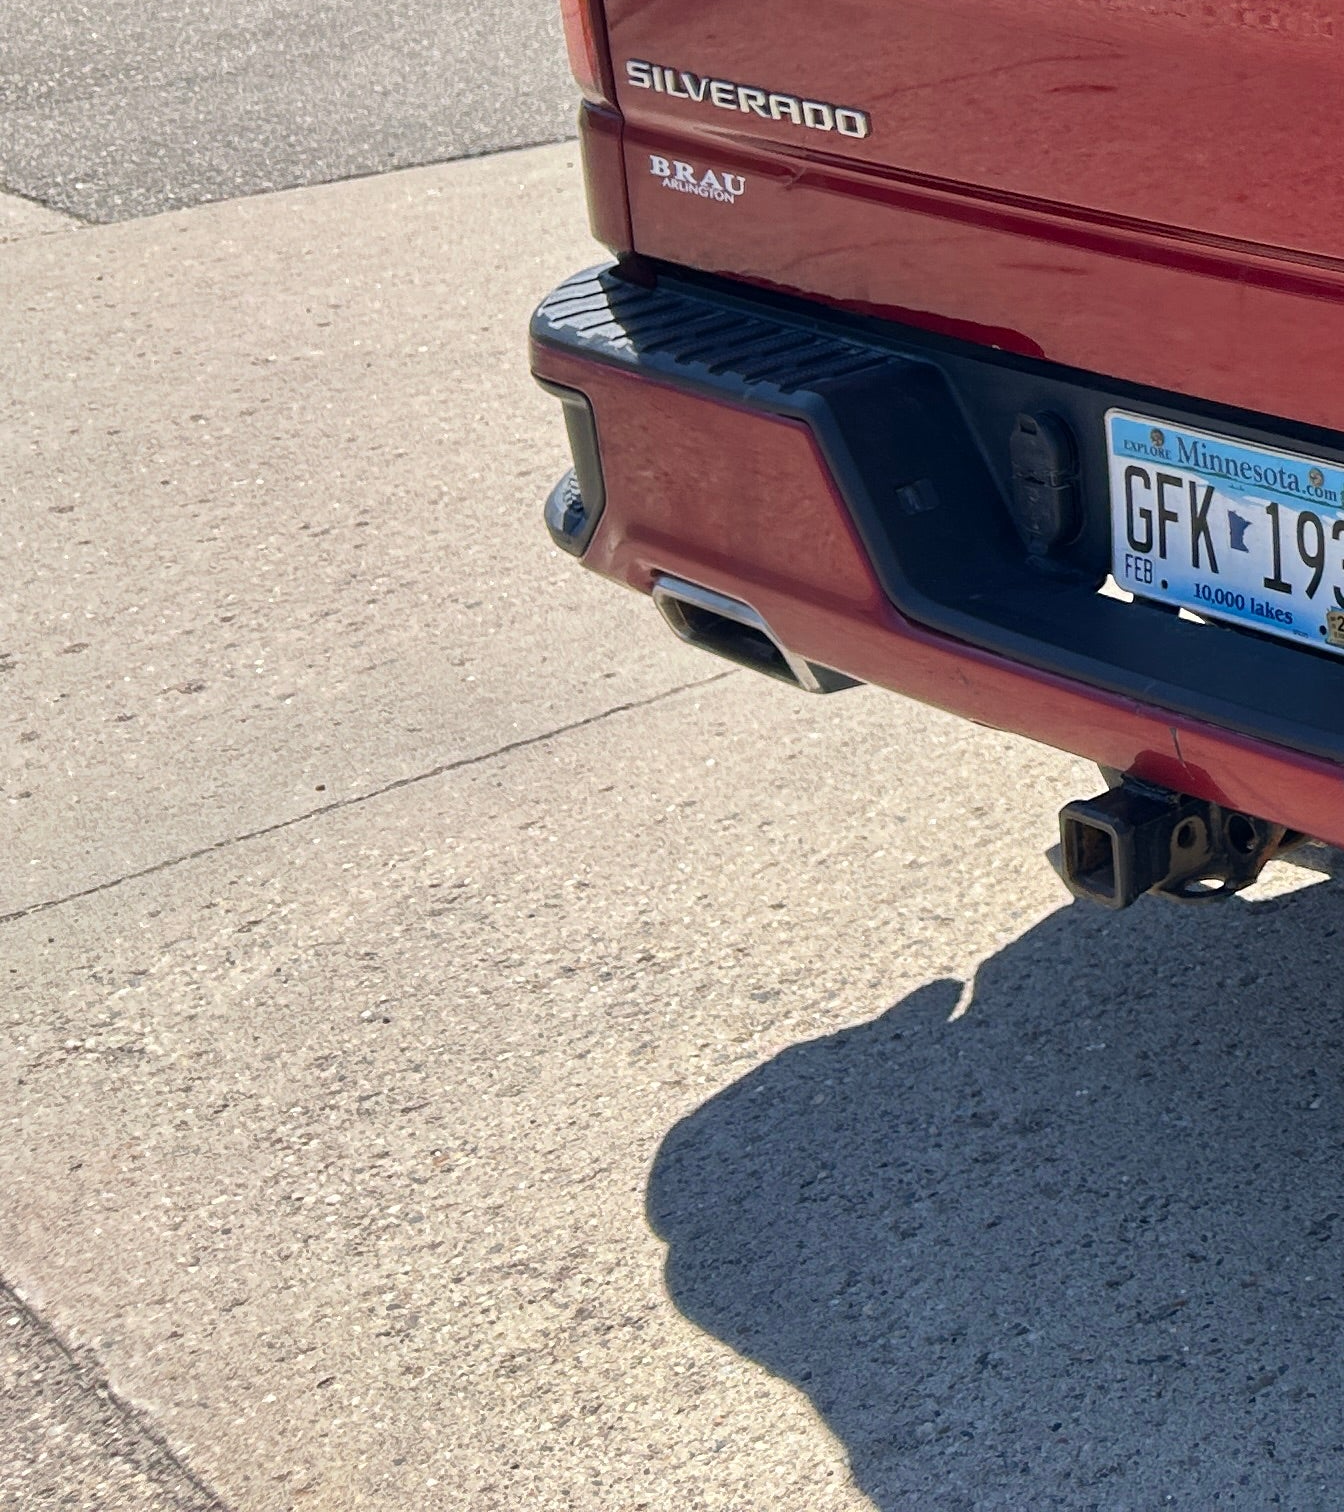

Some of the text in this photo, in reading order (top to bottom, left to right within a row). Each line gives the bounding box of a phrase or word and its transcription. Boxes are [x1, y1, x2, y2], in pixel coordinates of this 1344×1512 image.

[625, 58, 872, 139] SILVERADO
[649, 155, 746, 196] BRAU
[662, 176, 735, 205] ARLINGTON
[1123, 439, 1173, 461] EXPLORE
[1124, 465, 1220, 574] GFK
[1124, 553, 1153, 585] FEB
[1193, 582, 1294, 625] 10,000 lakes
